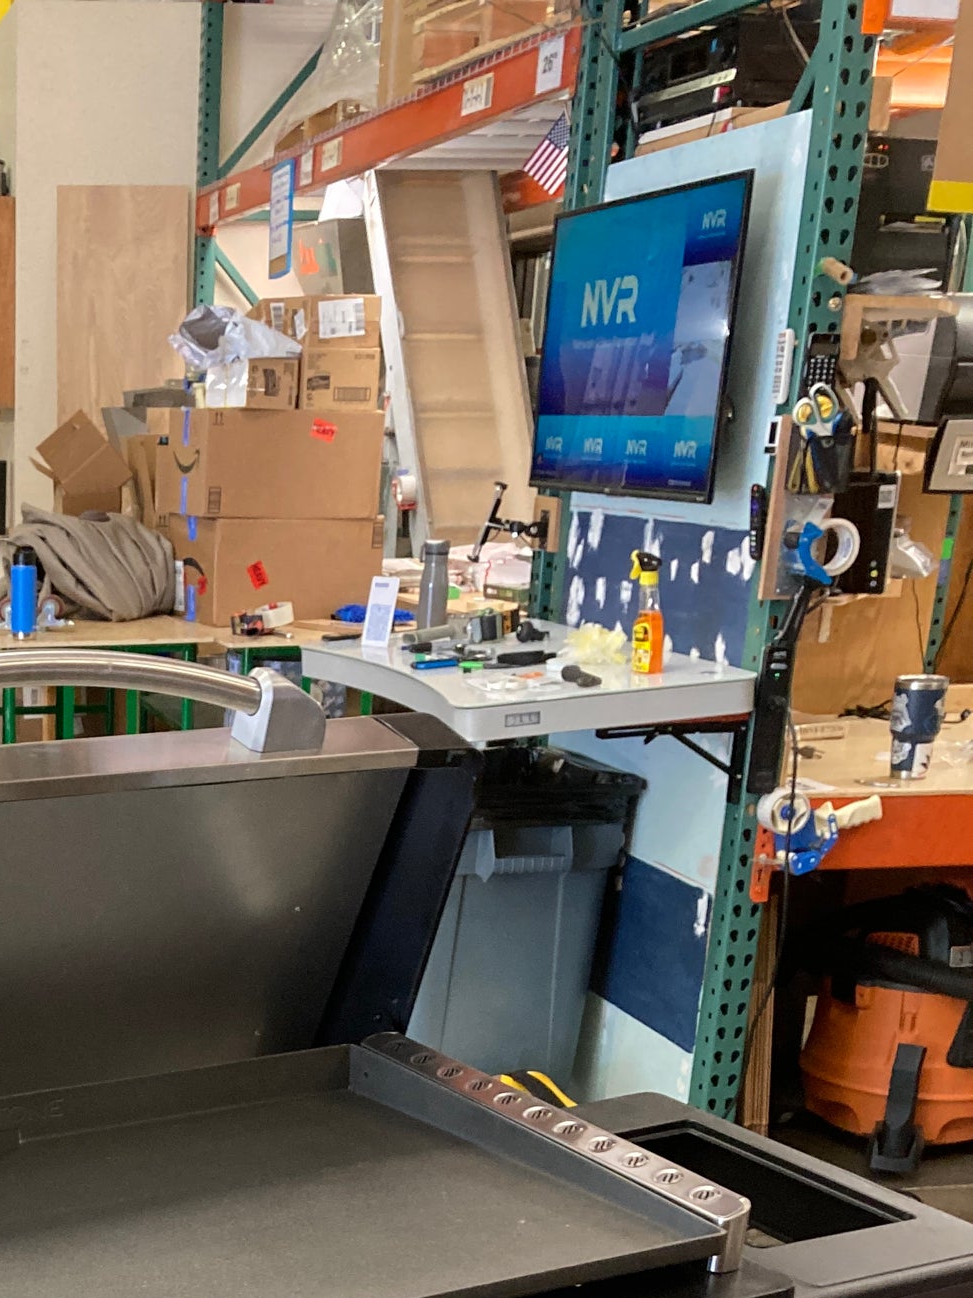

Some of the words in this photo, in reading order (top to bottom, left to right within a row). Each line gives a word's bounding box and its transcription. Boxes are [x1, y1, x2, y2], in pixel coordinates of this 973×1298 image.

[702, 208, 727, 230] NVR
[581, 275, 639, 328] NVR
[583, 437, 603, 454] NVR
[626, 439, 647, 457] NVR
[673, 440, 698, 459] NVR
